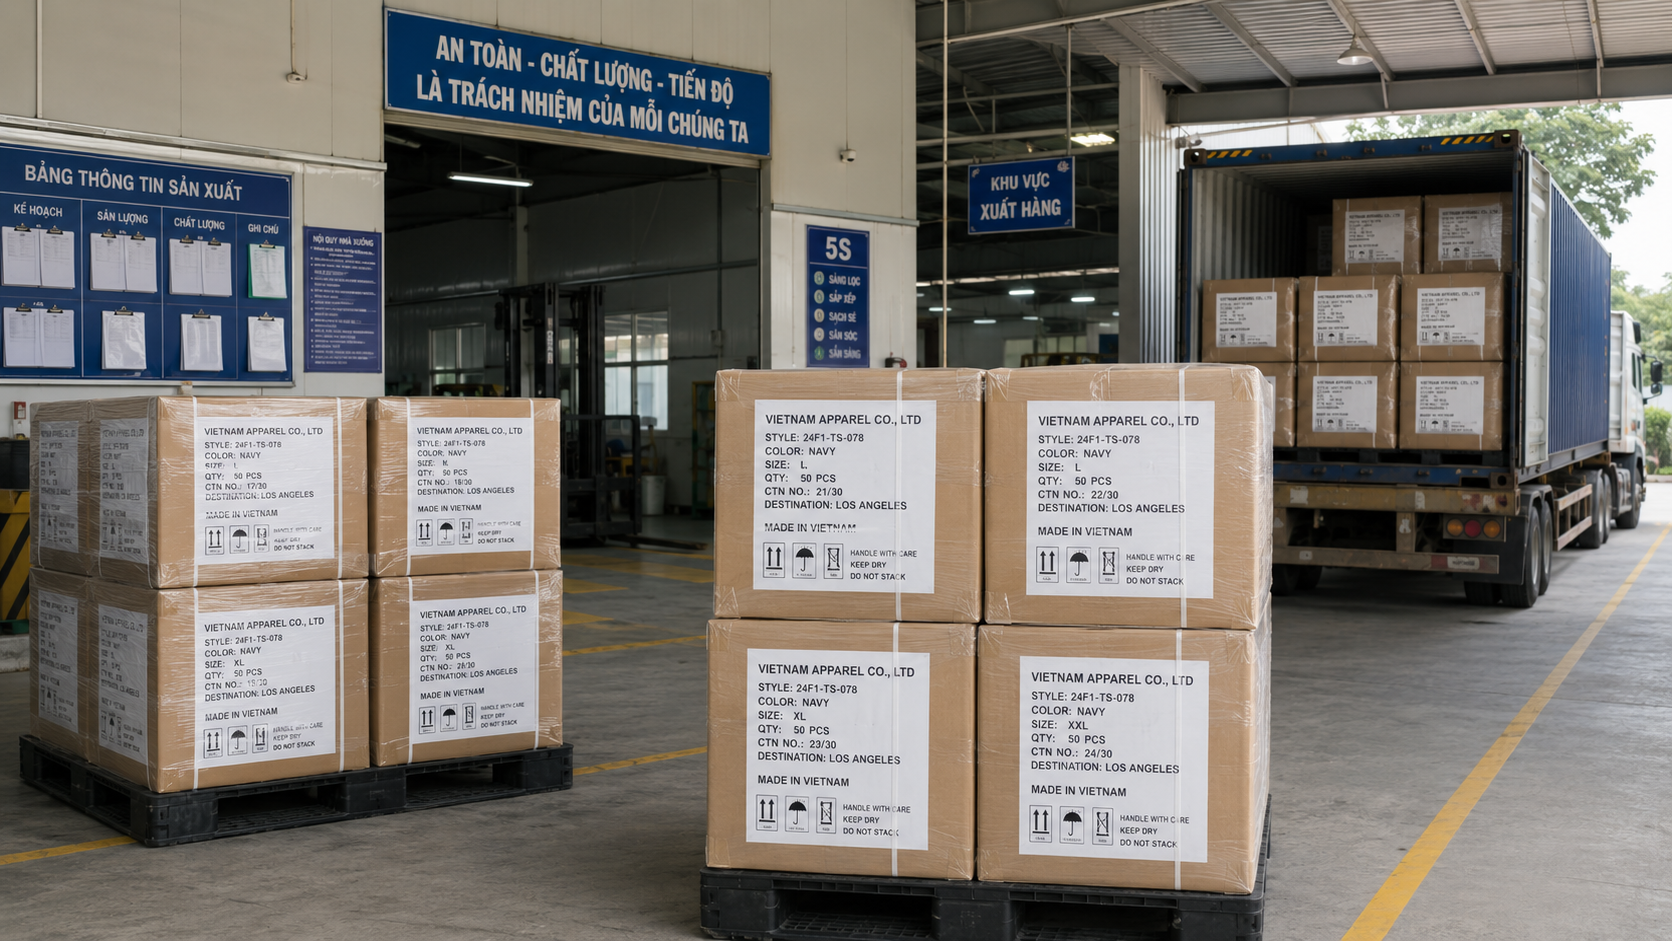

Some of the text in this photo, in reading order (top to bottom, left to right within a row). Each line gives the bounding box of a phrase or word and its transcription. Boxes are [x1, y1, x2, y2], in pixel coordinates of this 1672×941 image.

[436, 35, 463, 63] AN
[470, 39, 521, 72] TOÀN
[541, 48, 589, 82] CHẤT
[594, 60, 652, 93] LƯỢNG
[668, 68, 706, 101] TIẾN
[711, 77, 733, 109] ĐỘ
[417, 70, 749, 144] LÀ TRÁCH NHIỆM CỦA MỖI CHÚNG TA
[25, 160, 242, 201] BẢNG THÔNG TIN SẢN XUẤT
[991, 172, 1050, 191] KHU VỰC
[30, 205, 62, 218] HOẠCH
[980, 196, 1061, 220] XUẤT HÀNG
[248, 224, 279, 234] GHI CHÚ
[825, 236, 852, 262] 5S
[766, 415, 921, 426] VIETNAM APPAREL CO., LTD
[1039, 416, 1199, 427] VIETNAM APPAREL CO., LTD
[288, 428, 306, 436] CO.,
[765, 433, 864, 442] STYLE: 24F1-TS-078
[1038, 435, 1140, 444] STYLE: 24F1-TS-078
[765, 447, 836, 455] COLOR: NAVY
[1038, 449, 1111, 458] COLOR: NAVY
[1038, 463, 1081, 471] SIZE: L
[765, 474, 836, 483] QTY: 50 PCS
[1038, 477, 1112, 486] QTY: 50 PCS
[765, 488, 843, 496] CTN NO.: 21/30
[1038, 490, 1119, 499] CTN NO.: 22/30
[765, 501, 907, 510] DESTINATION: LOS ANGELES
[1038, 504, 1185, 513] DESTINATION: LOS ANGELES
[420, 610, 455, 618] VIETNAM
[458, 608, 493, 616] APPAREL
[495, 607, 511, 615] CO.,
[204, 617, 325, 632] VIETNAM APPAREL CO., LTD
[758, 664, 915, 678] VIETNAM APPAREL CO., LTD
[1032, 672, 1193, 686] VIETNAM APPAREL CO., LTD
[420, 691, 441, 699] MADE
[453, 688, 484, 697] VIETNAM
[758, 683, 858, 694] STYLE: 24F1-TS-078
[758, 697, 829, 707] COLOR: NAVY
[1032, 692, 1135, 702] STYLE: 24F1-TS-078
[758, 711, 806, 720] SIZE: XL
[1032, 706, 1106, 716] COLOR: NAVY
[758, 725, 830, 735] QTY: 50 PCS
[1032, 720, 1088, 730] SIZE: XXL
[758, 738, 837, 749] CTN NO.: 23/30
[1032, 734, 1106, 744] QTY: 50 PCS
[1031, 747, 1112, 758] CTN NO.: 24/30
[758, 752, 901, 764] DESTINATION: LOS ANGELES
[1031, 761, 1179, 774] DESTINATION: LOS ANGELES
